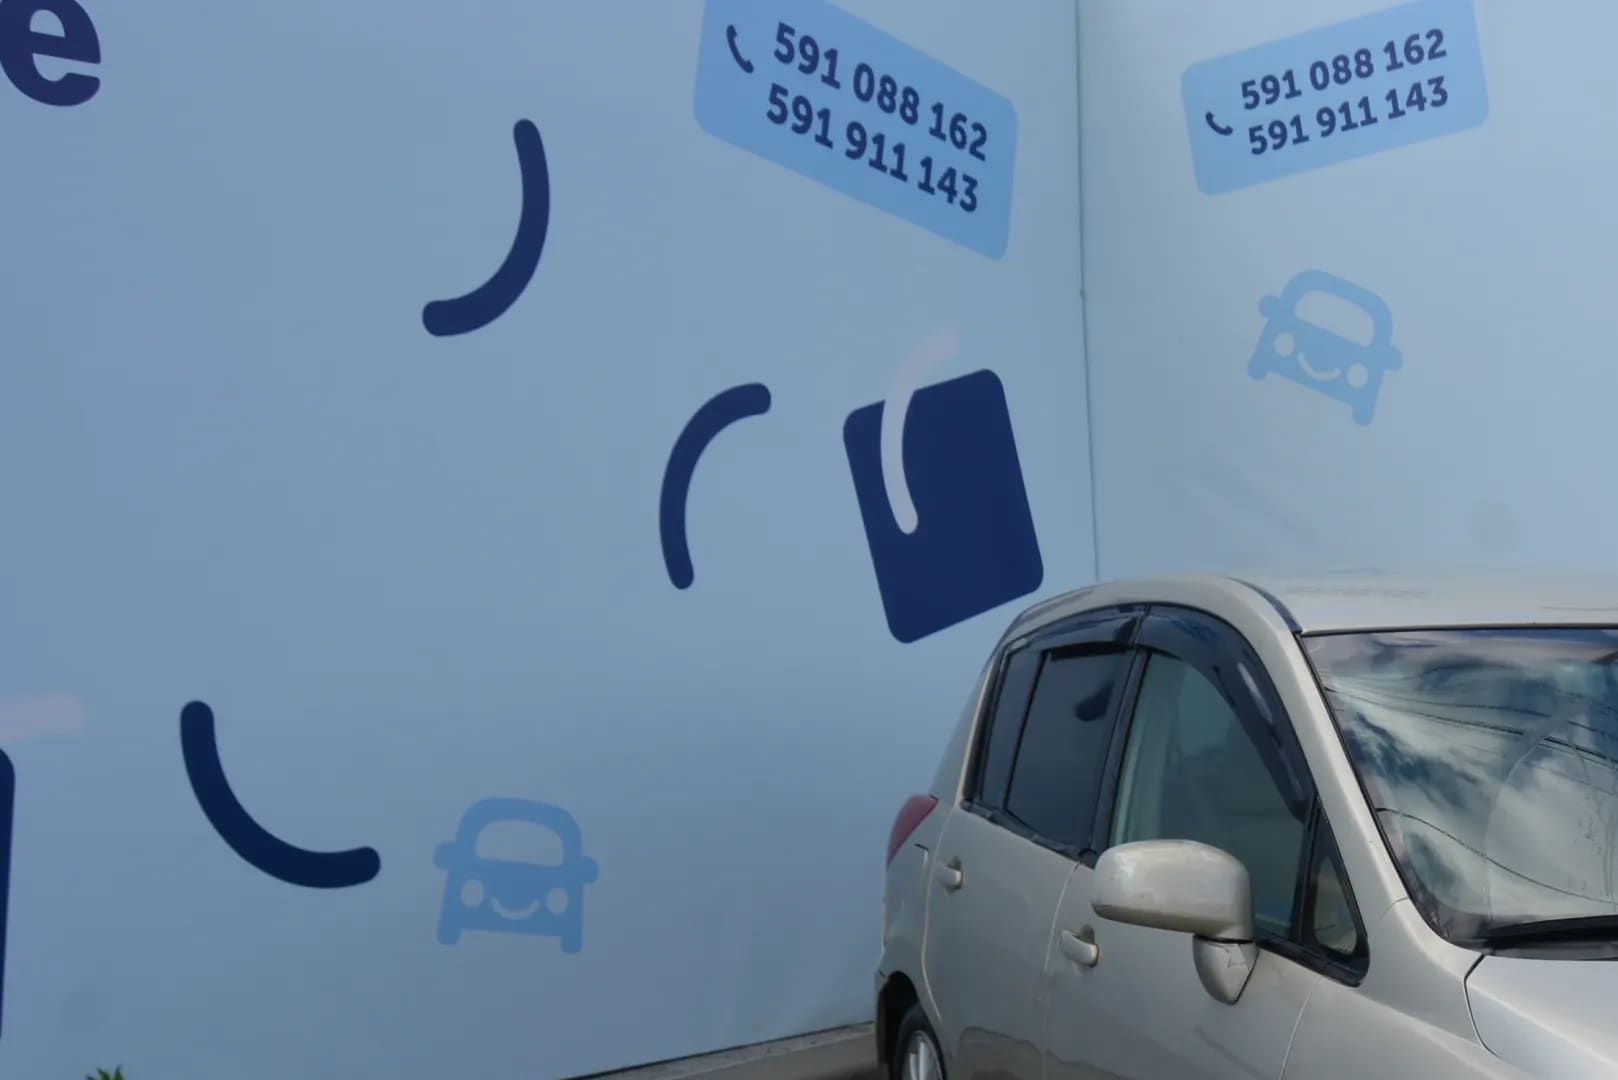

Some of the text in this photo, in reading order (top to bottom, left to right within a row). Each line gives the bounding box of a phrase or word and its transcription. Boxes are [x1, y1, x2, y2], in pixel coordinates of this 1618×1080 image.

[774, 22, 987, 161] 591 088 162
[1242, 29, 1446, 110] 591 088 162
[1249, 76, 1448, 155] 591 911 143
[767, 83, 978, 212] 591 911 143
